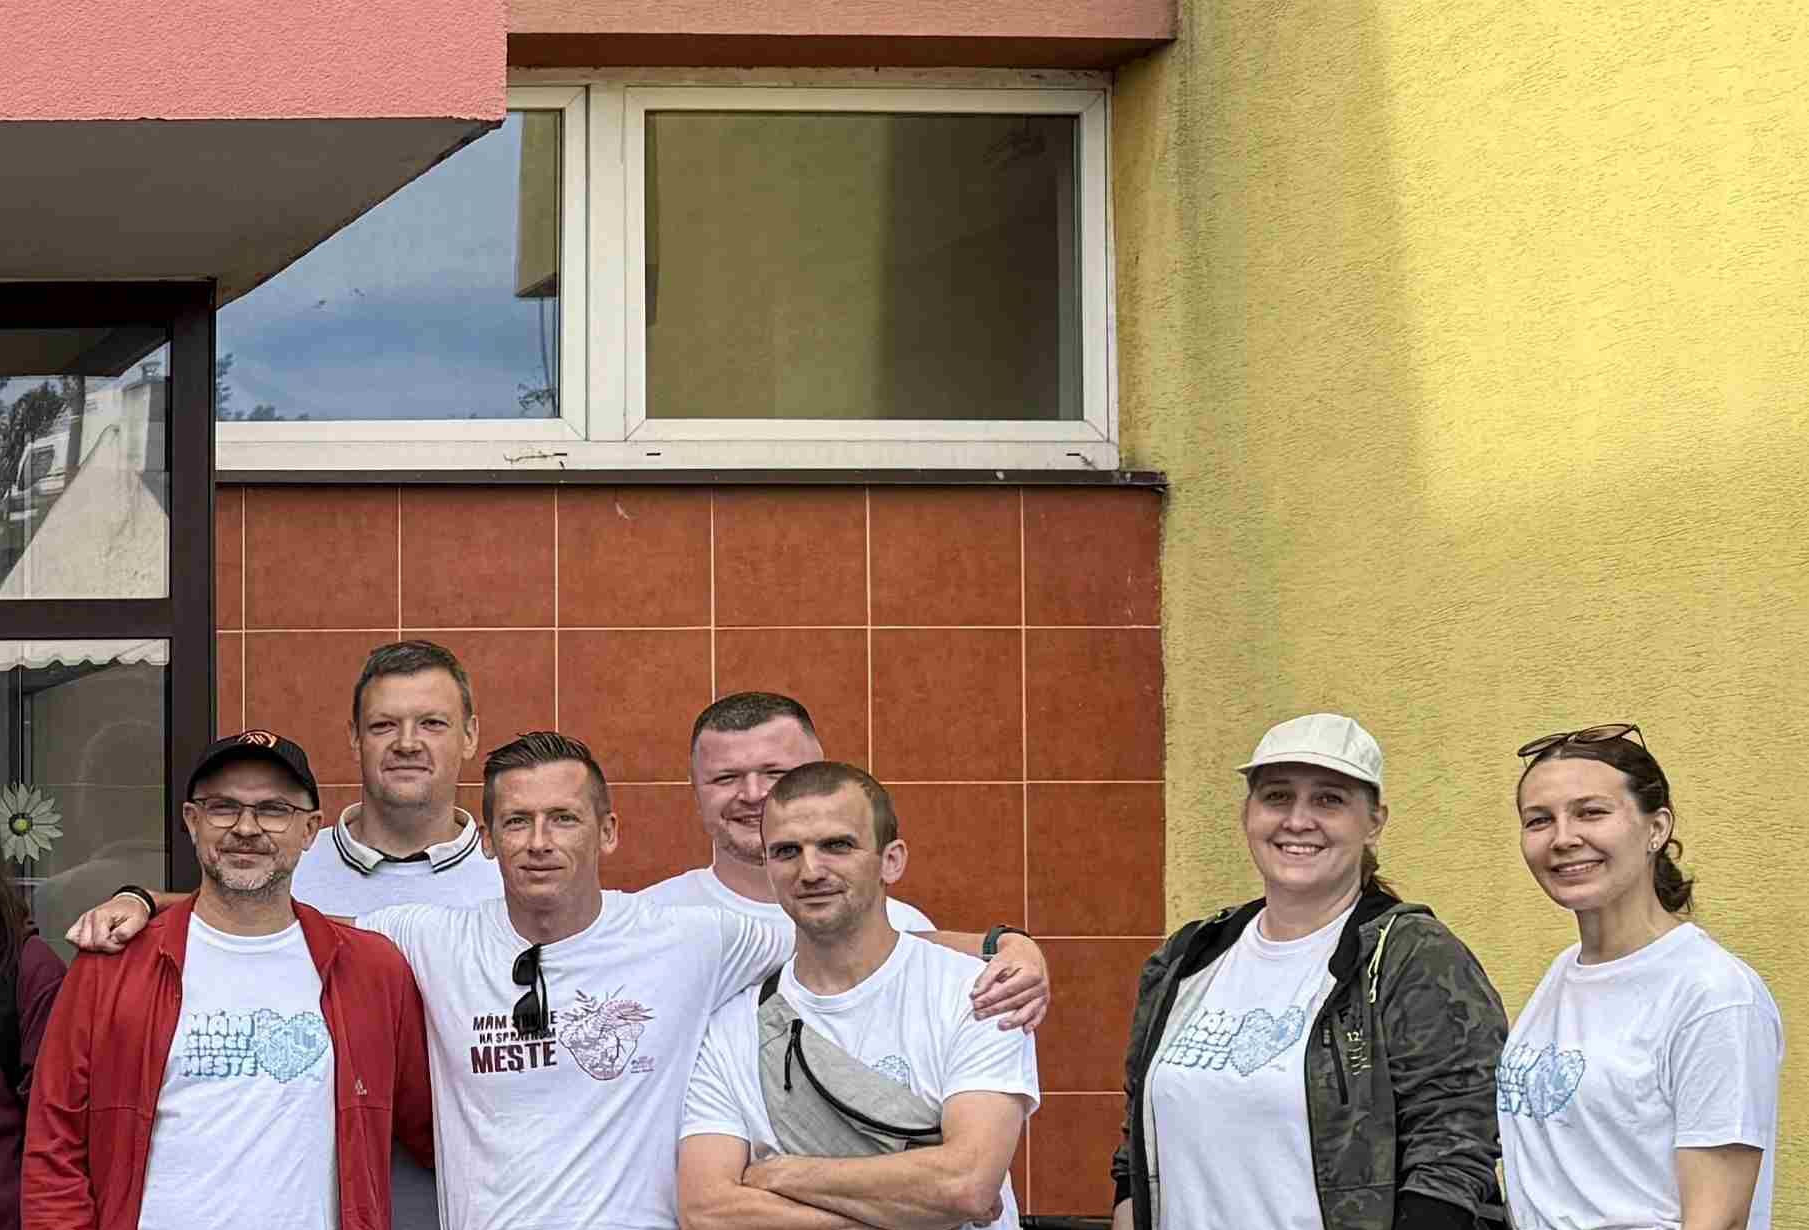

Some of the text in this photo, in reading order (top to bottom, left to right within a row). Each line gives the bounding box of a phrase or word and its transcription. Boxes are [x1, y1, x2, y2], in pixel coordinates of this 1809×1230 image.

[185, 1010, 255, 1038] MÁM
[472, 1013, 508, 1031] MÁM
[182, 1055, 258, 1077] MESTE
[471, 1040, 558, 1074] MESTE
